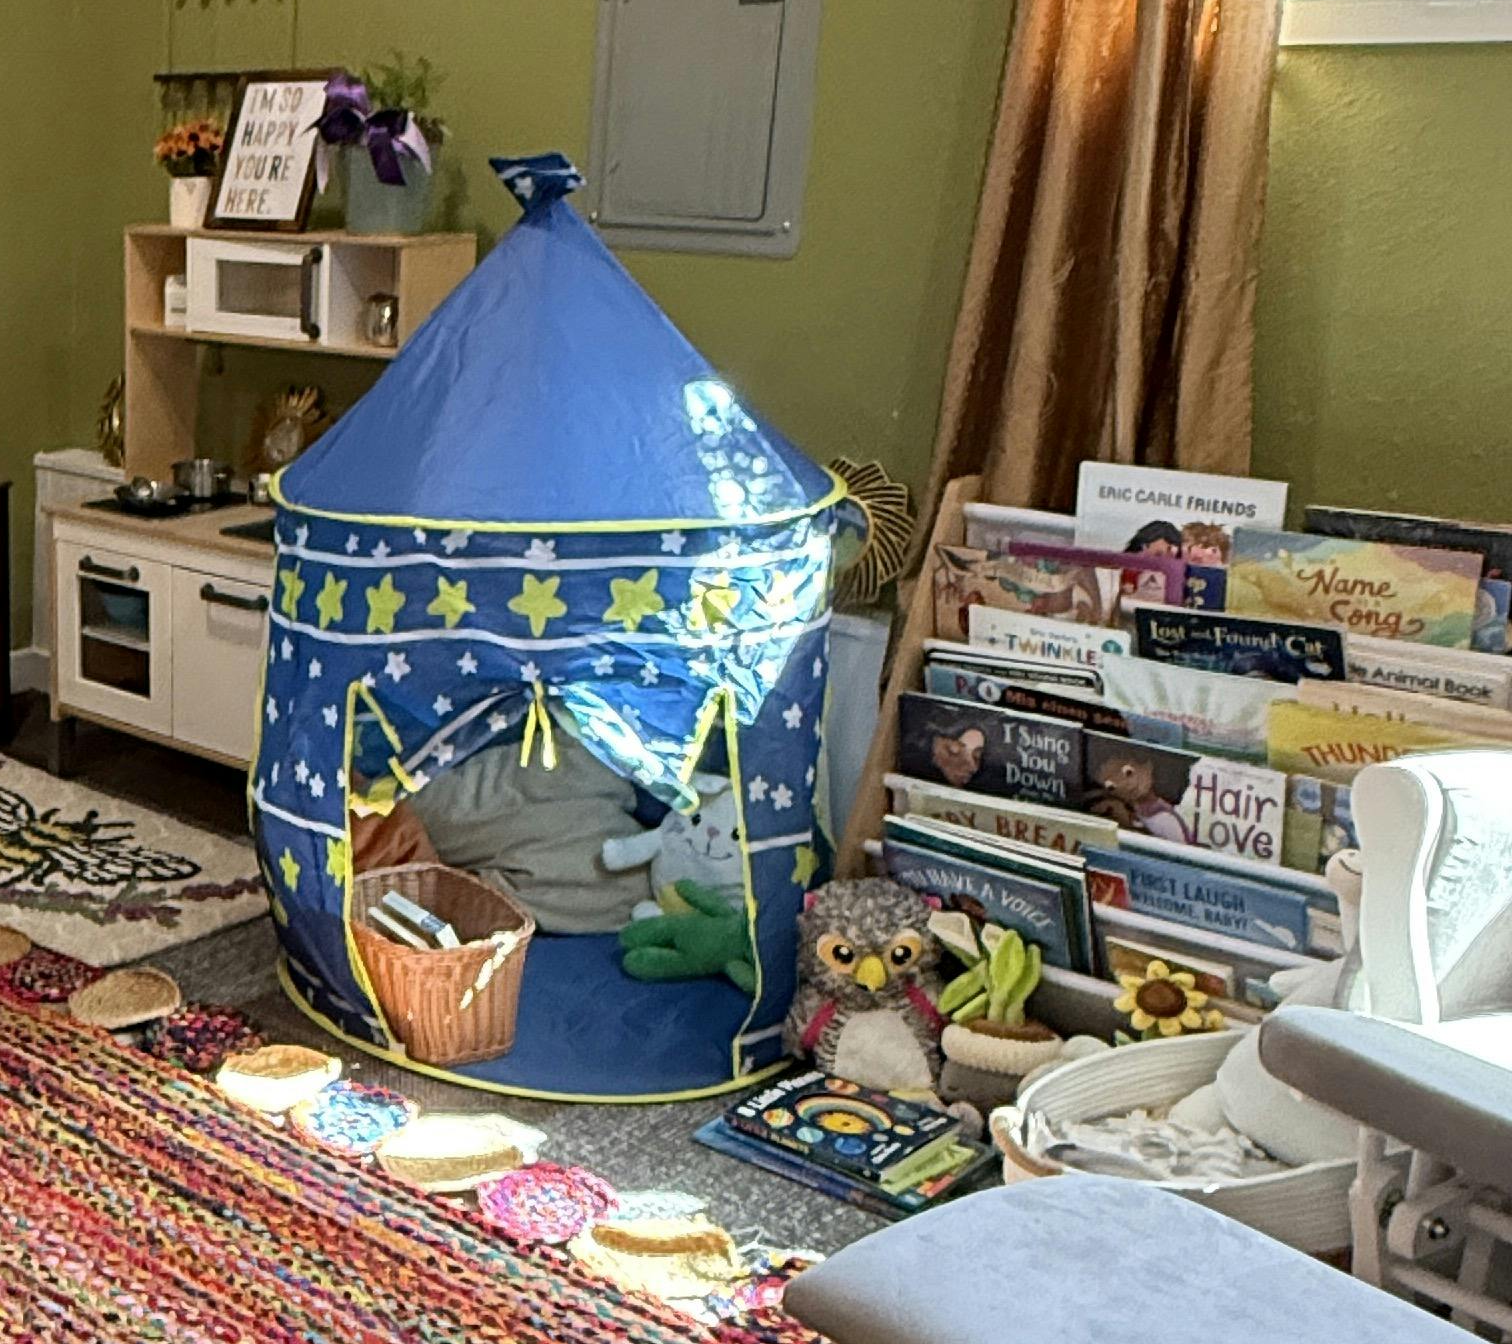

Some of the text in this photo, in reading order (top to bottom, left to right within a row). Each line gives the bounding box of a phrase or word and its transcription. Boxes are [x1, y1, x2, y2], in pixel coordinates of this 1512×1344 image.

[279, 87, 304, 113] SO
[241, 120, 299, 147] HAPPY
[1099, 485, 1256, 518] ERIC CARLE FRIENDS
[1296, 566, 1397, 598] Name
[1330, 599, 1426, 637] Song
[1150, 619, 1186, 642] Lost
[1213, 625, 1277, 649] Found
[1285, 634, 1325, 660] Cat
[1372, 665, 1440, 690] Animal
[1444, 678, 1494, 699] Book
[1003, 722, 1071, 766] I Sang
[1016, 745, 1057, 774] You
[1301, 742, 1410, 767] THUND
[1006, 762, 1067, 801] Down
[1194, 772, 1278, 823] Hair
[1190, 811, 1274, 860] Love
[981, 882, 995, 901] A
[1184, 884, 1247, 913] LAUGH
